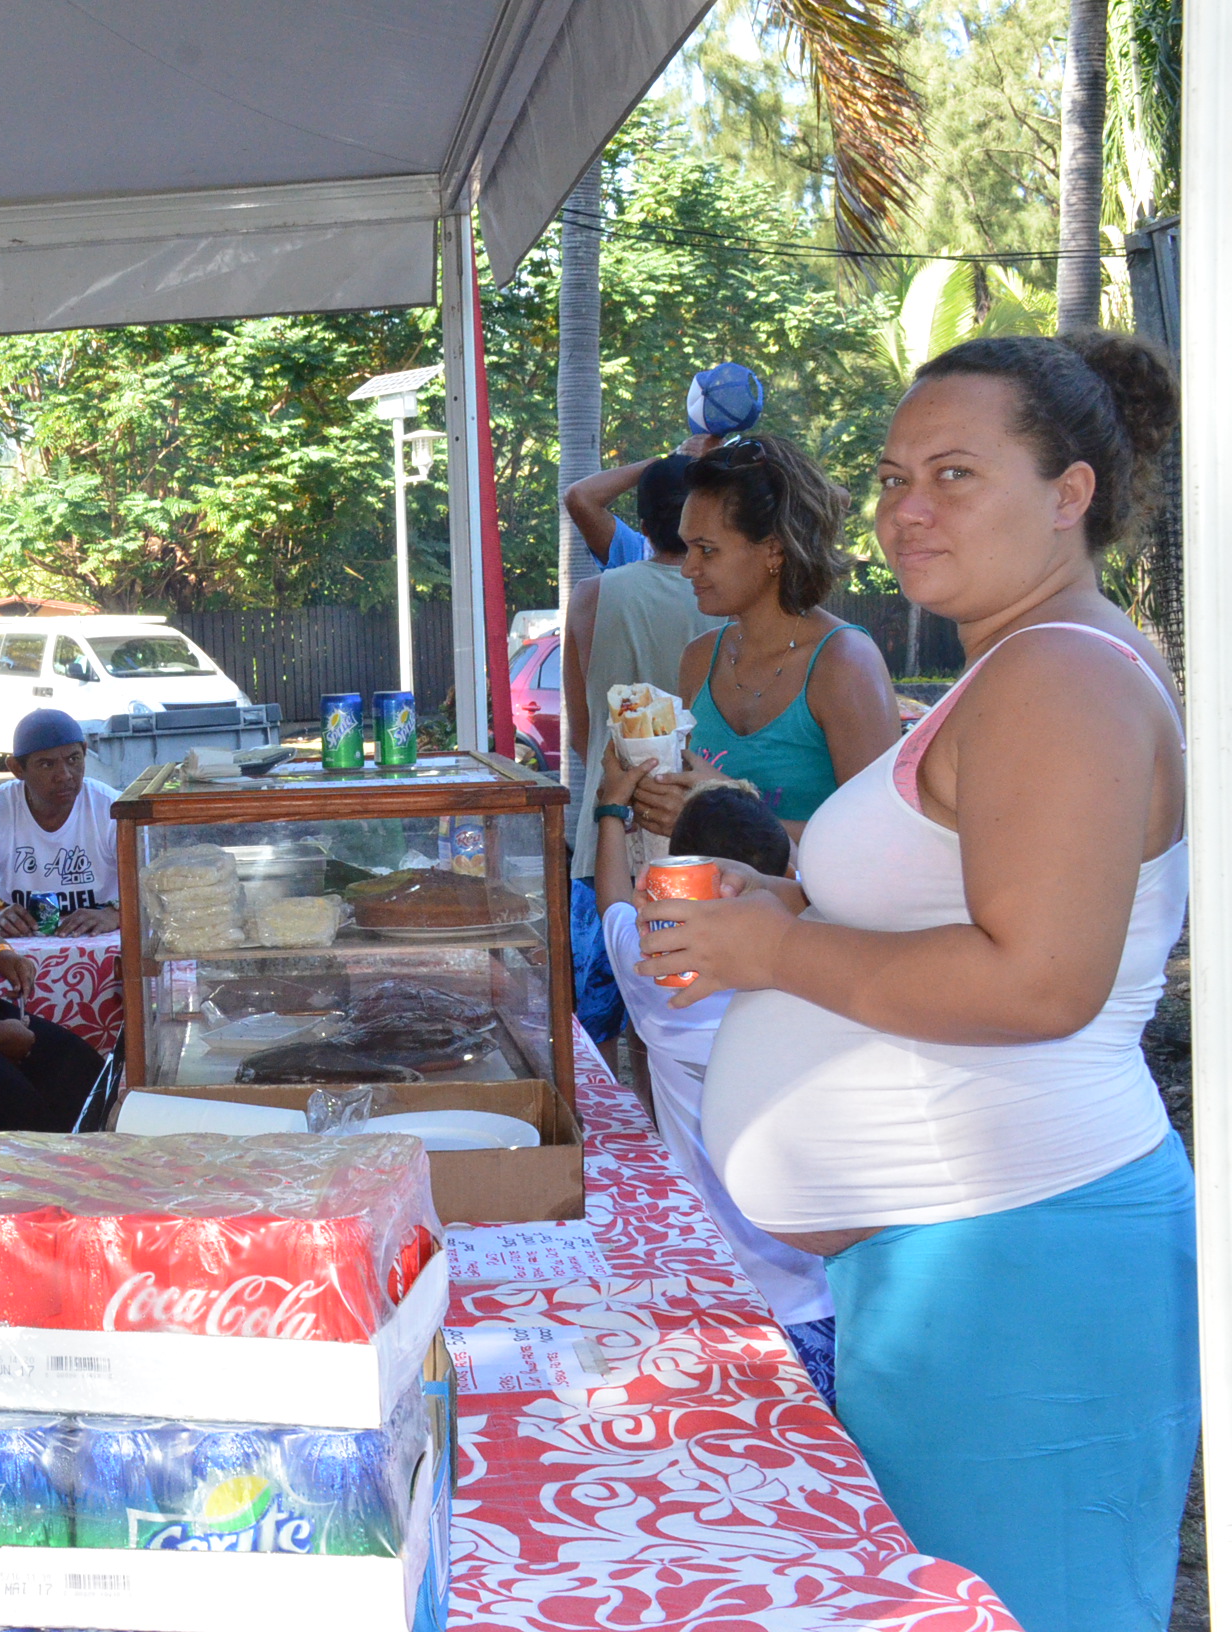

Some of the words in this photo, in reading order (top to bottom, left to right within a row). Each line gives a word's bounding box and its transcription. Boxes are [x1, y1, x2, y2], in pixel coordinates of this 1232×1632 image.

[15, 846, 38, 874] Te
[44, 845, 92, 878] Aito
[60, 871, 95, 886] 2016
[38, 1584, 54, 1596] 17
